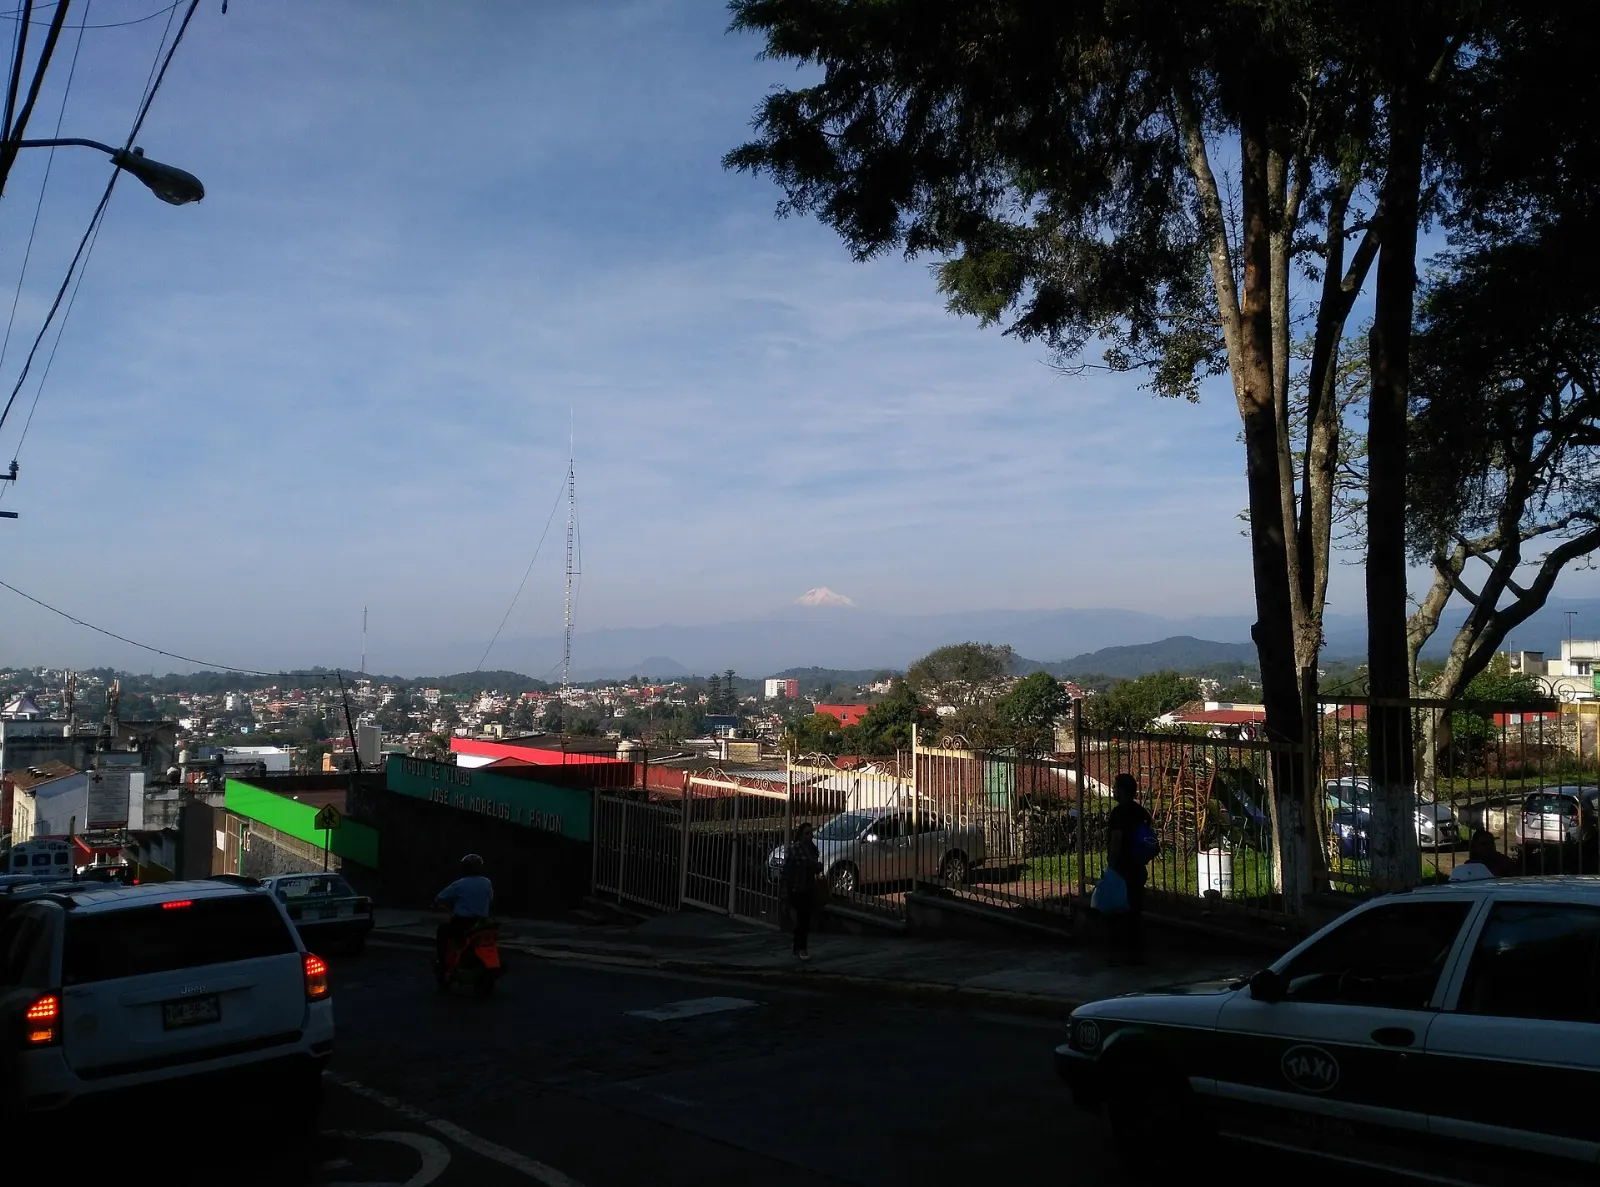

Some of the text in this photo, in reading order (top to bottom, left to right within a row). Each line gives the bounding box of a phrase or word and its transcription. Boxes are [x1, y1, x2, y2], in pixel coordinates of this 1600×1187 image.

[430, 763, 440, 780] DE
[469, 795, 511, 820] MORELOS
[517, 806, 524, 822] Y
[180, 985, 206, 995] Jeep
[1286, 1056, 1334, 1083] TAXI
